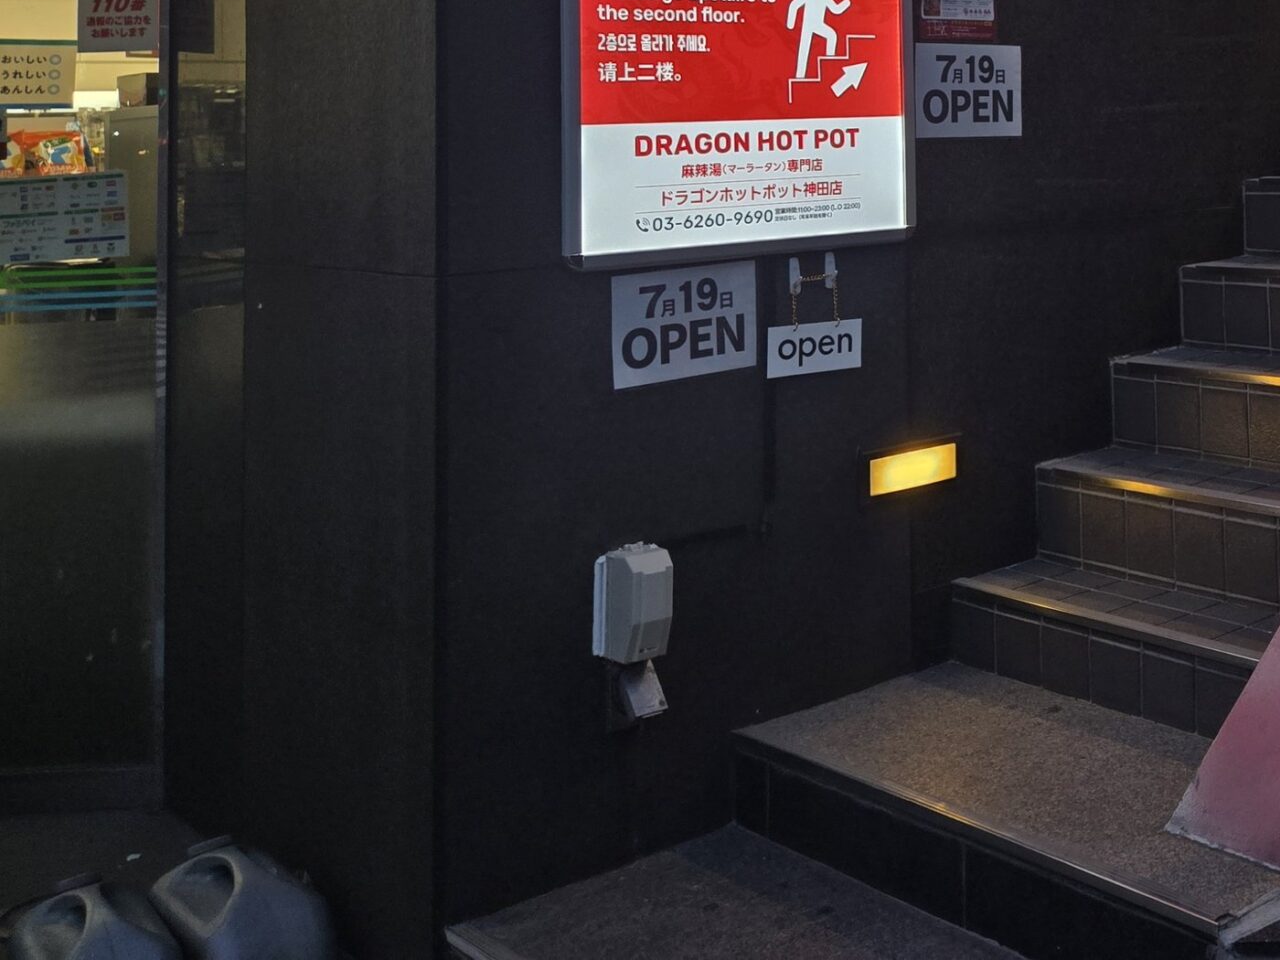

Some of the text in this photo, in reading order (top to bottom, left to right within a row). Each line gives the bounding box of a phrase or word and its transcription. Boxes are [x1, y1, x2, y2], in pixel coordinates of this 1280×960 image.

[597, 5, 745, 23] the second floor.
[598, 33, 637, 52] 2층으로
[641, 34, 673, 52] 올라가
[598, 62, 682, 83] 请上二楼。
[936, 55, 1005, 84] 7月19日
[923, 89, 1013, 124] OPEN
[634, 128, 860, 158] DRAGON HOT POT
[661, 181, 843, 207] ドラゴンホットポット神田店
[652, 210, 773, 232] 03-6260-9690
[639, 277, 733, 318] 7月19日
[621, 313, 745, 369] OPEN
[778, 333, 852, 367] open
